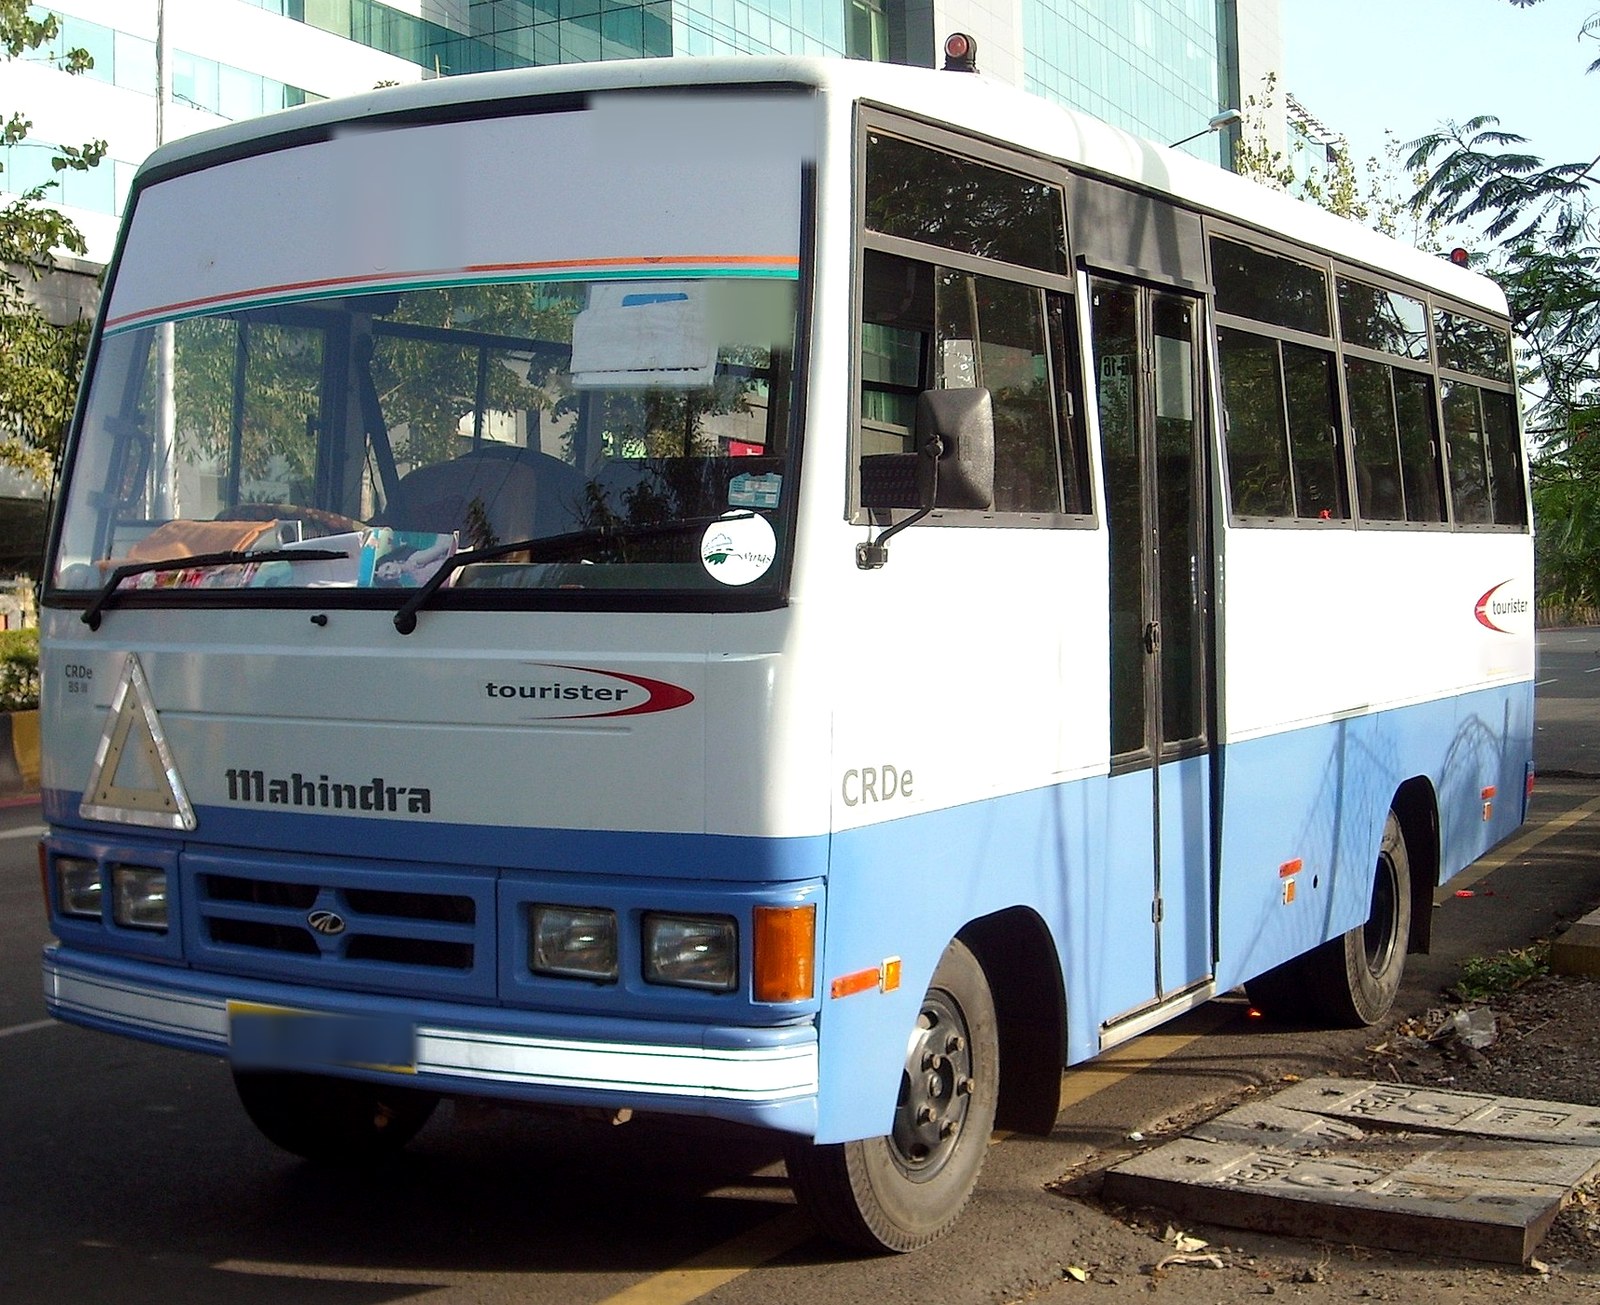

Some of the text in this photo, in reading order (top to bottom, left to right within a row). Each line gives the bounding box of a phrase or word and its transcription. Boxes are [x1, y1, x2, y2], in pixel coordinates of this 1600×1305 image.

[1492, 598, 1528, 615] tourister
[65, 664, 93, 679] CRDe
[68, 681, 79, 693] BS
[486, 682, 629, 701] tourister
[225, 769, 431, 814] Mahindra
[842, 764, 914, 807] CRDe
